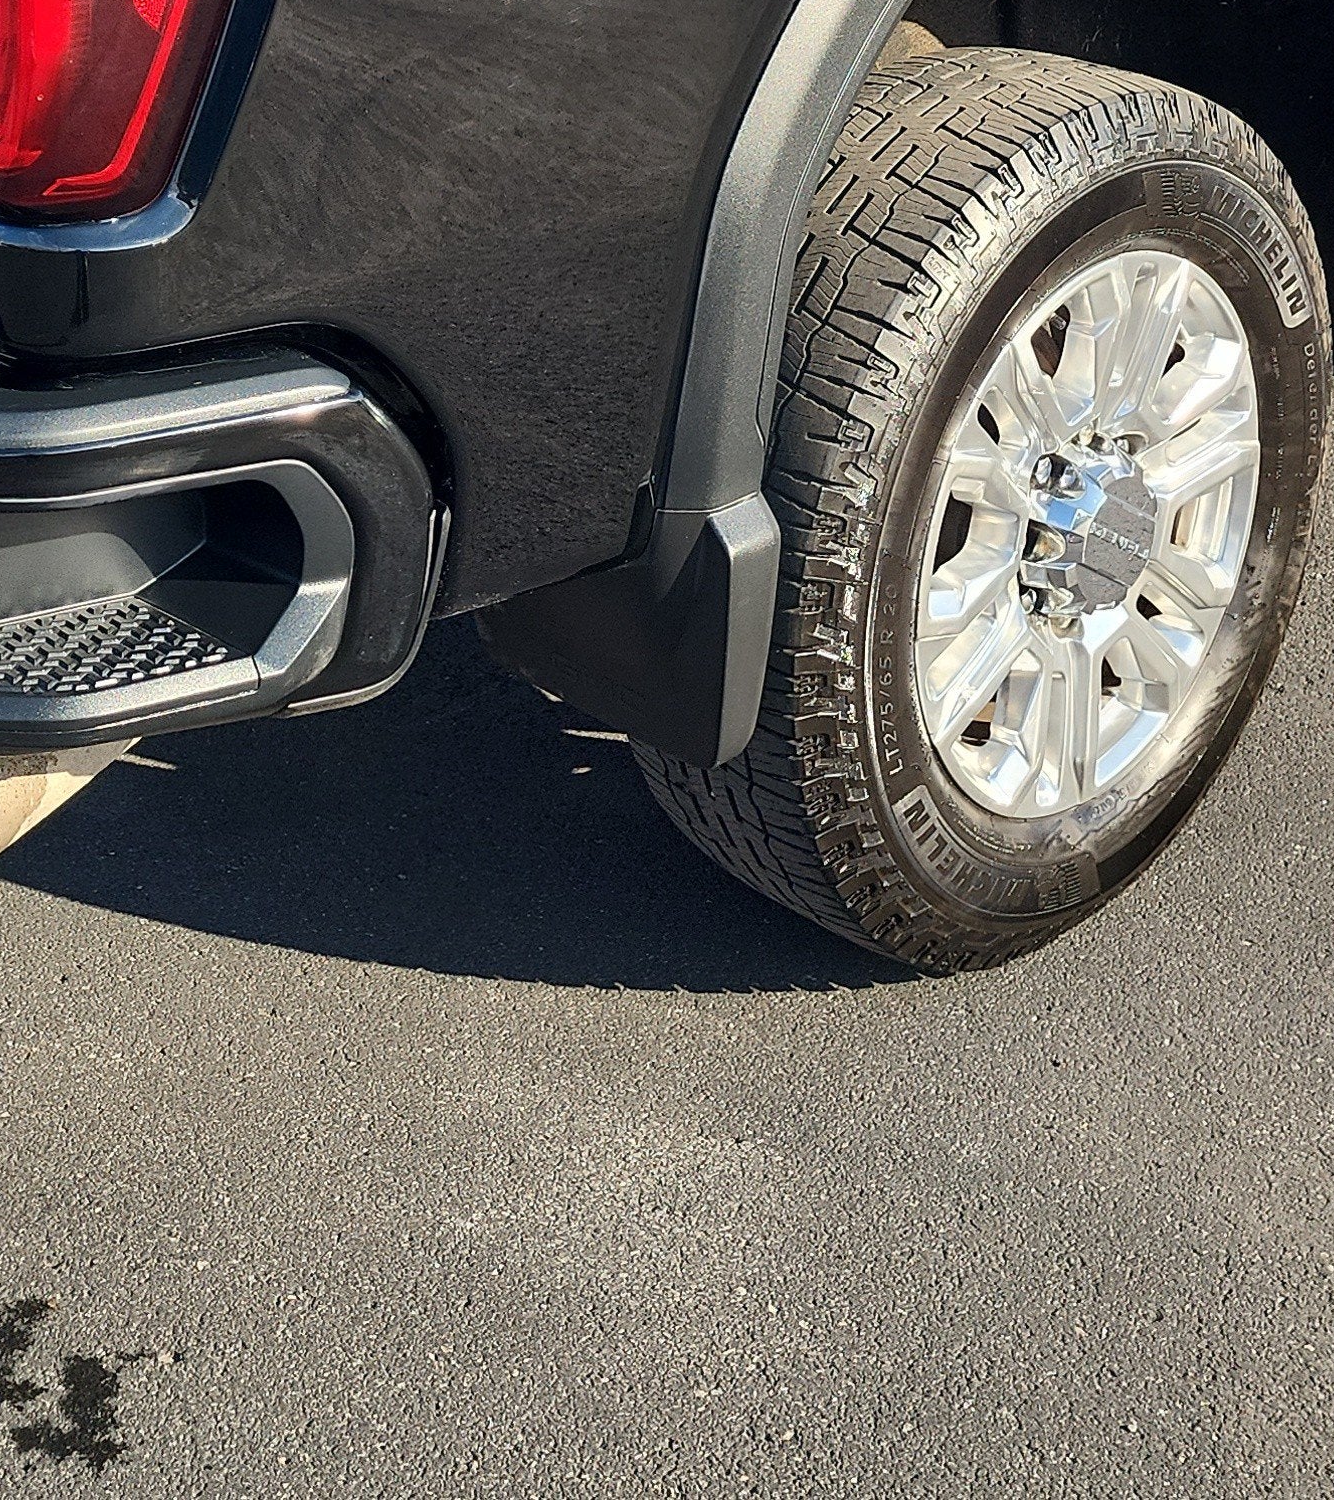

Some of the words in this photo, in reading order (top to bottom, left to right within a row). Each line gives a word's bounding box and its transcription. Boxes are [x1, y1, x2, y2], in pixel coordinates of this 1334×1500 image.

[1206, 184, 1307, 318] MICHELIN
[882, 584, 899, 616] 20
[879, 630, 896, 646] R
[903, 798, 1037, 910] MICHELIN
